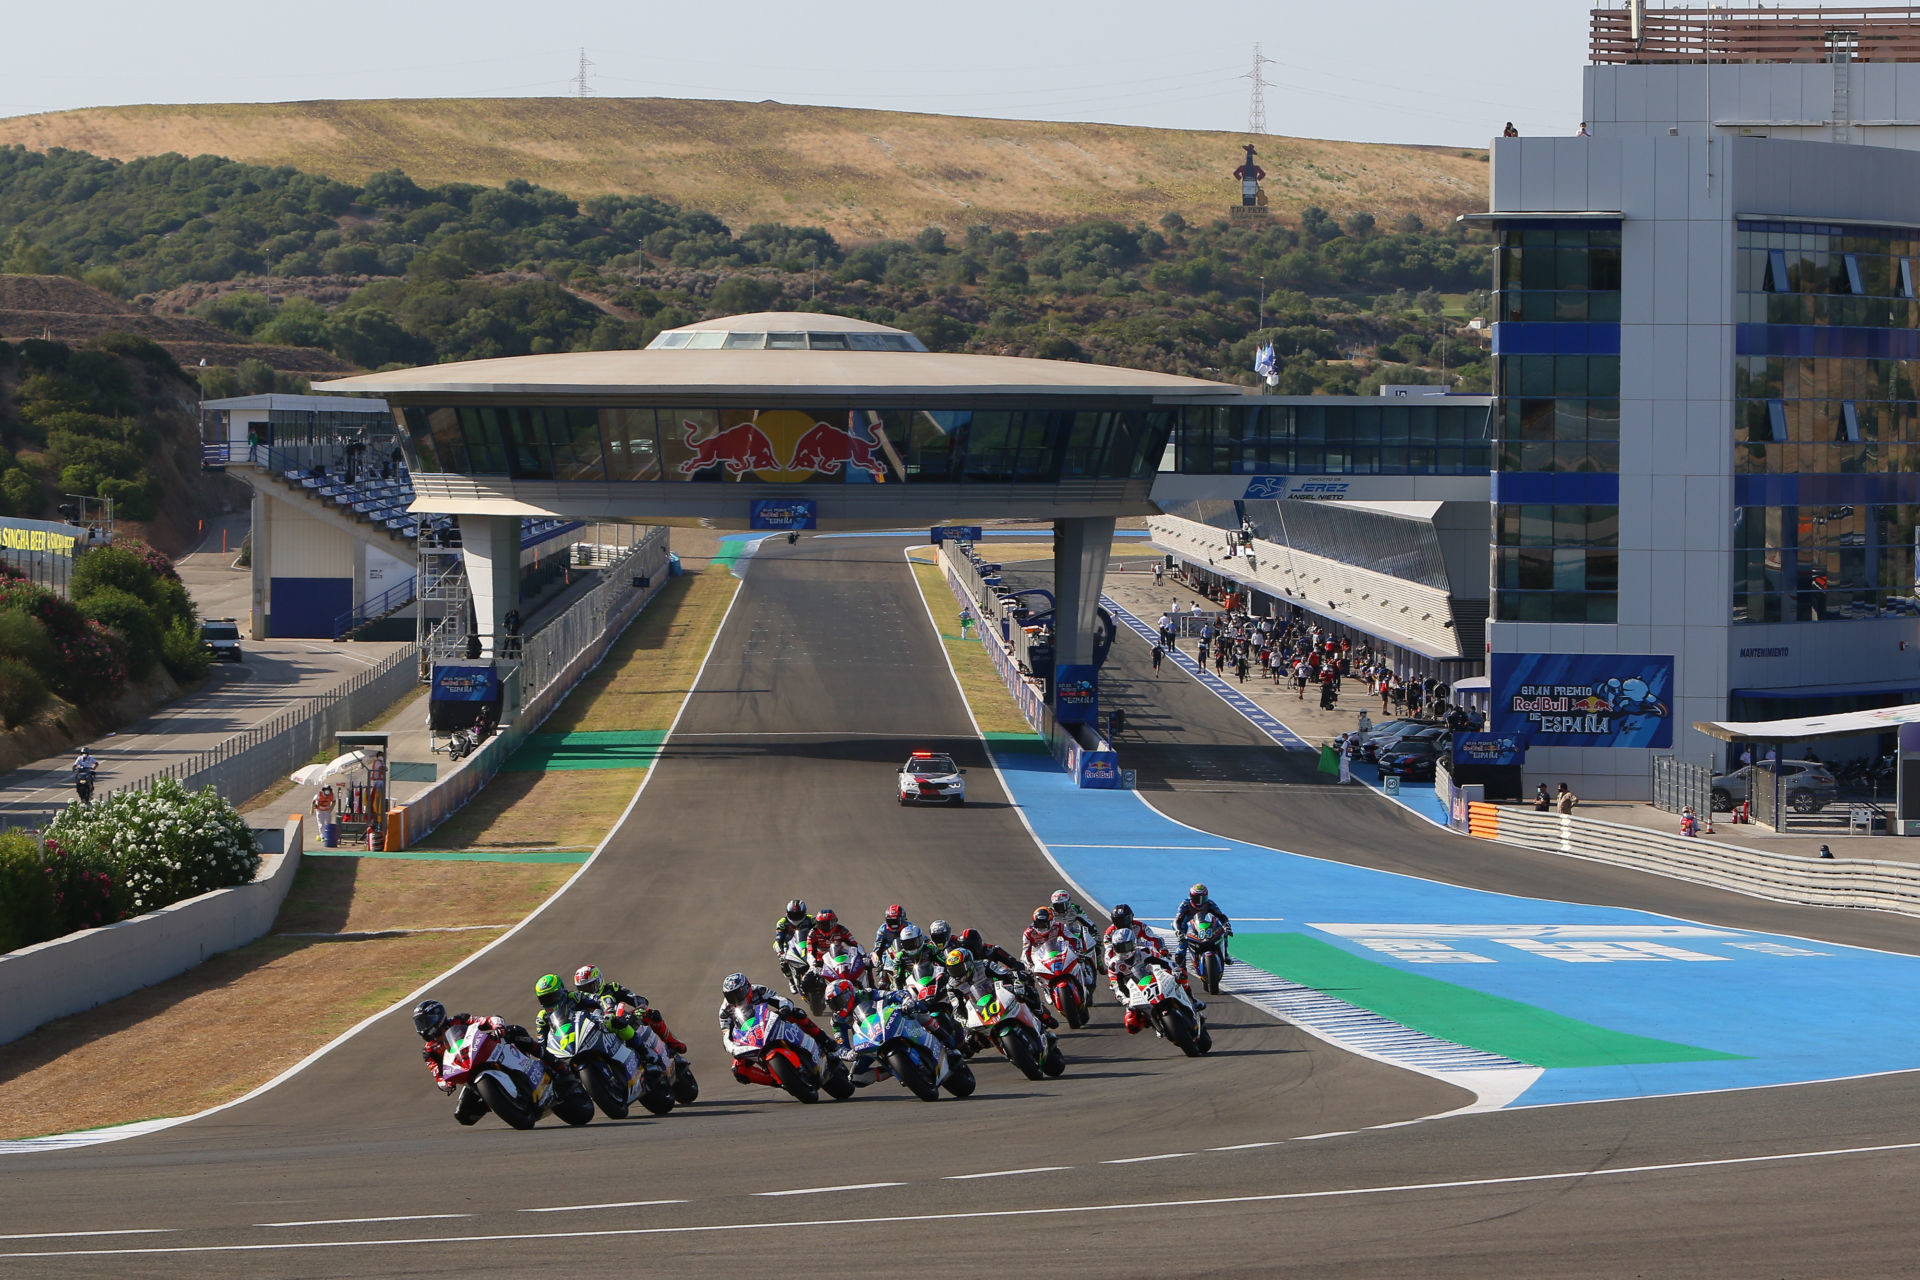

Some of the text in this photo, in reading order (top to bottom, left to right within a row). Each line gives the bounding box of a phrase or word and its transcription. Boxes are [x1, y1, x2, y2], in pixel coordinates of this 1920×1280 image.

[1291, 483, 1350, 492] JEREZ
[2, 528, 30, 550] SINGHA
[30, 530, 46, 552] BEER
[1740, 647, 1789, 658] MANTENIMIENTO
[1521, 686, 1592, 696] GRAN PREMIO
[1514, 696, 1568, 712] Red Bull
[1530, 712, 1542, 720] DE
[1541, 713, 1610, 733] ESPAÑA
[918, 984, 937, 1000] 66
[1143, 982, 1160, 1002] 27
[981, 1001, 1000, 1023] 10
